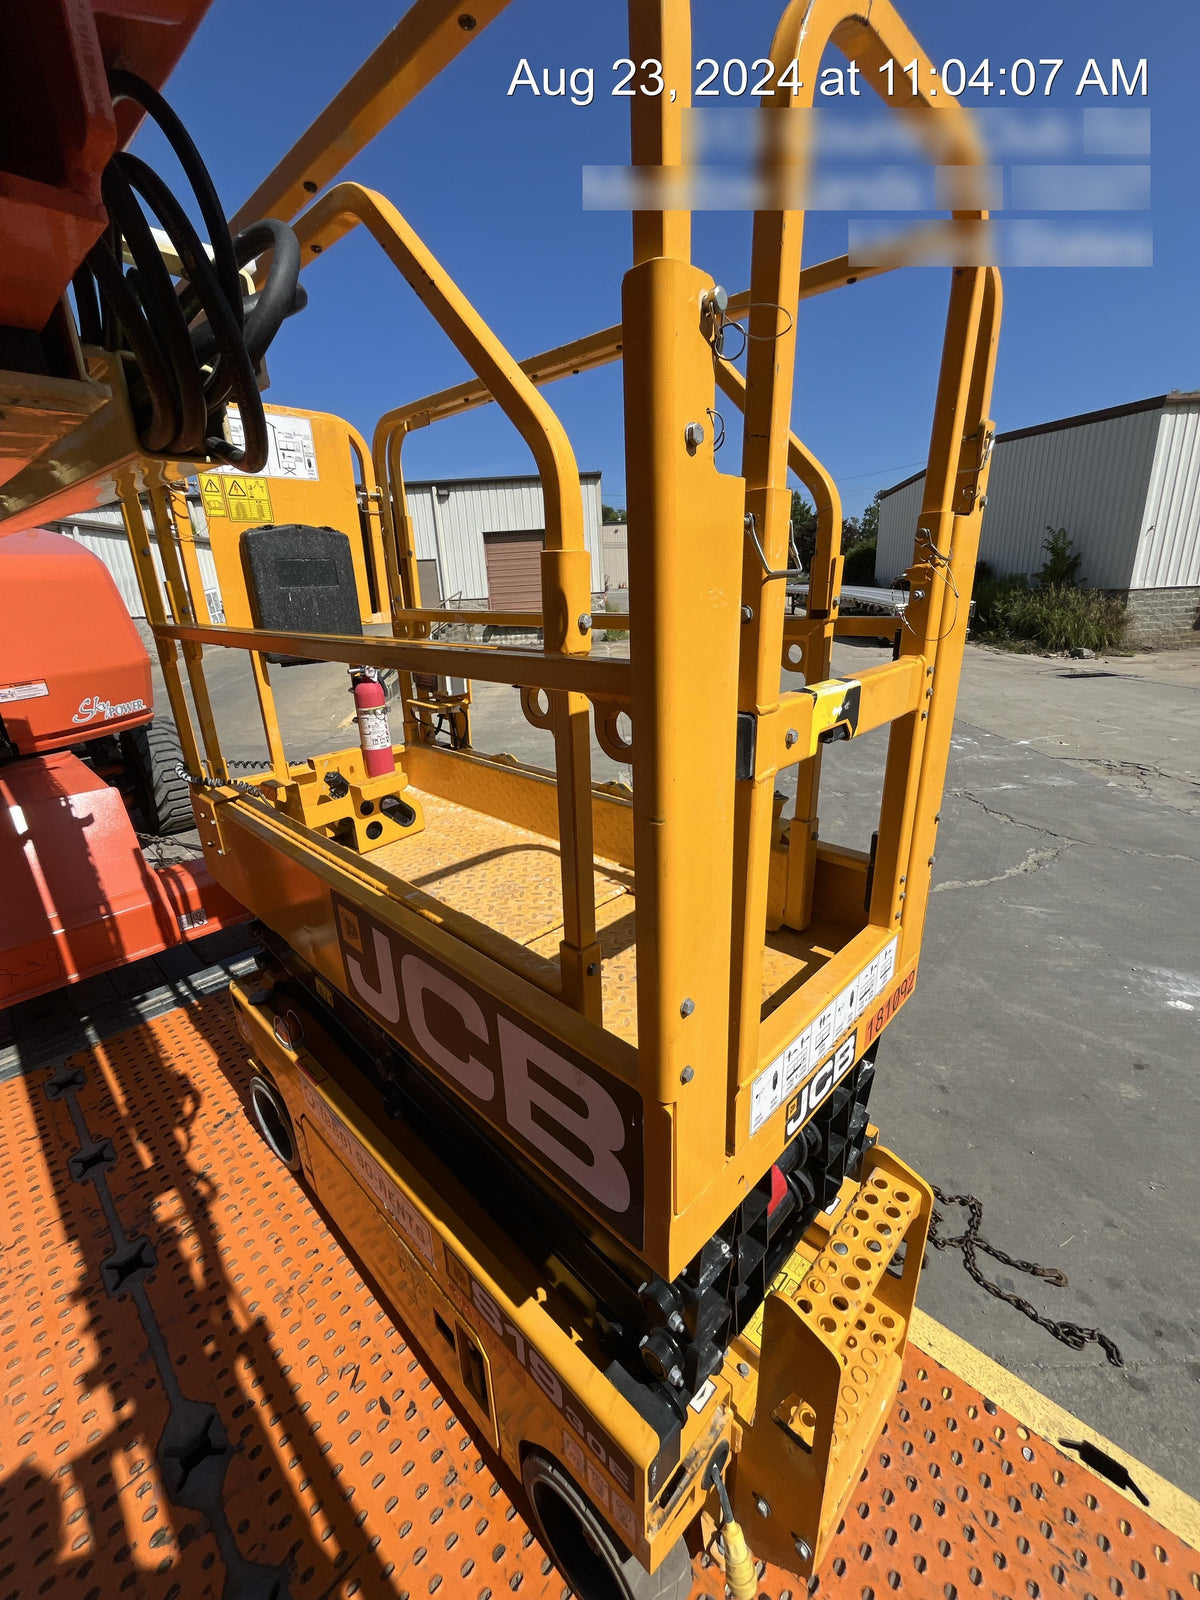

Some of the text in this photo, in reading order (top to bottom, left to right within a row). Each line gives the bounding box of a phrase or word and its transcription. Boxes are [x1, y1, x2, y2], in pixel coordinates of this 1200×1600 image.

[866, 968, 916, 1042] 181092
[346, 926, 631, 1213] JCB
[786, 1034, 856, 1137] JCB
